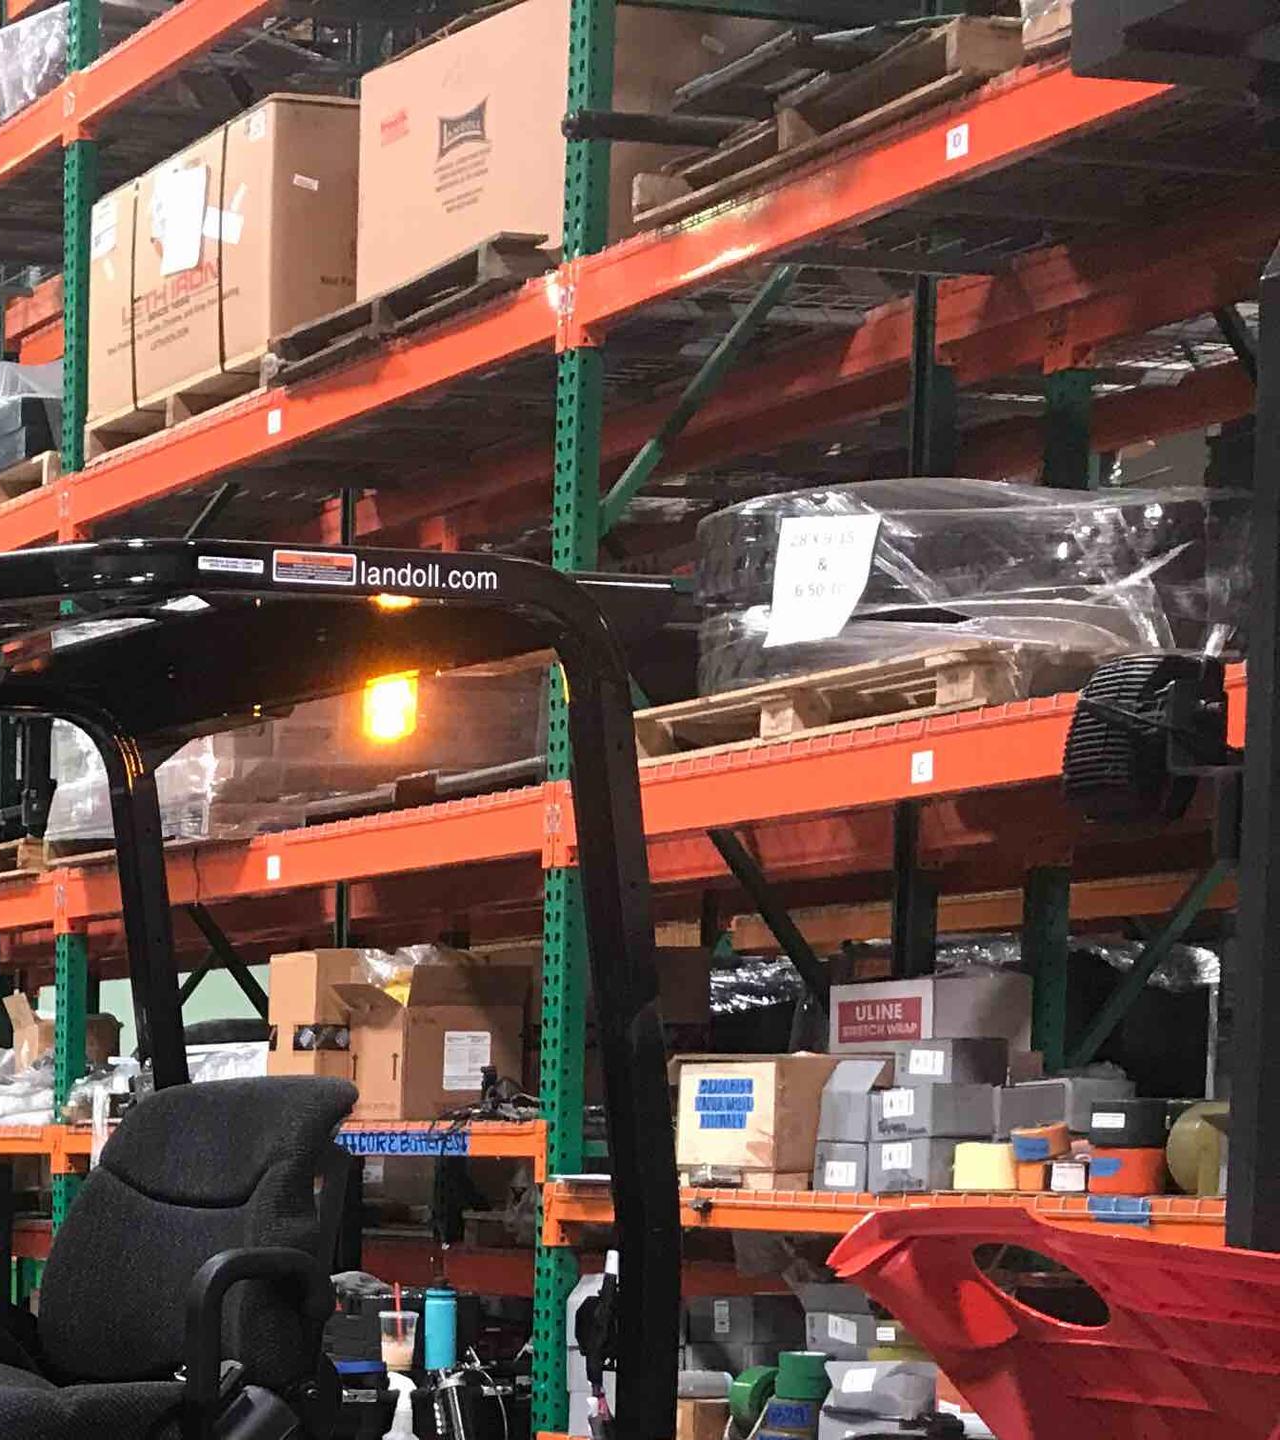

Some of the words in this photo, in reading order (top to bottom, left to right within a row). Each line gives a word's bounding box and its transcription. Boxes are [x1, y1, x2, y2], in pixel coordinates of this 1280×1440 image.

[817, 557, 828, 572] &
[360, 560, 499, 590] landoll.com
[855, 1003, 903, 1021] ULINE
[887, 1022, 918, 1036] WRAP
